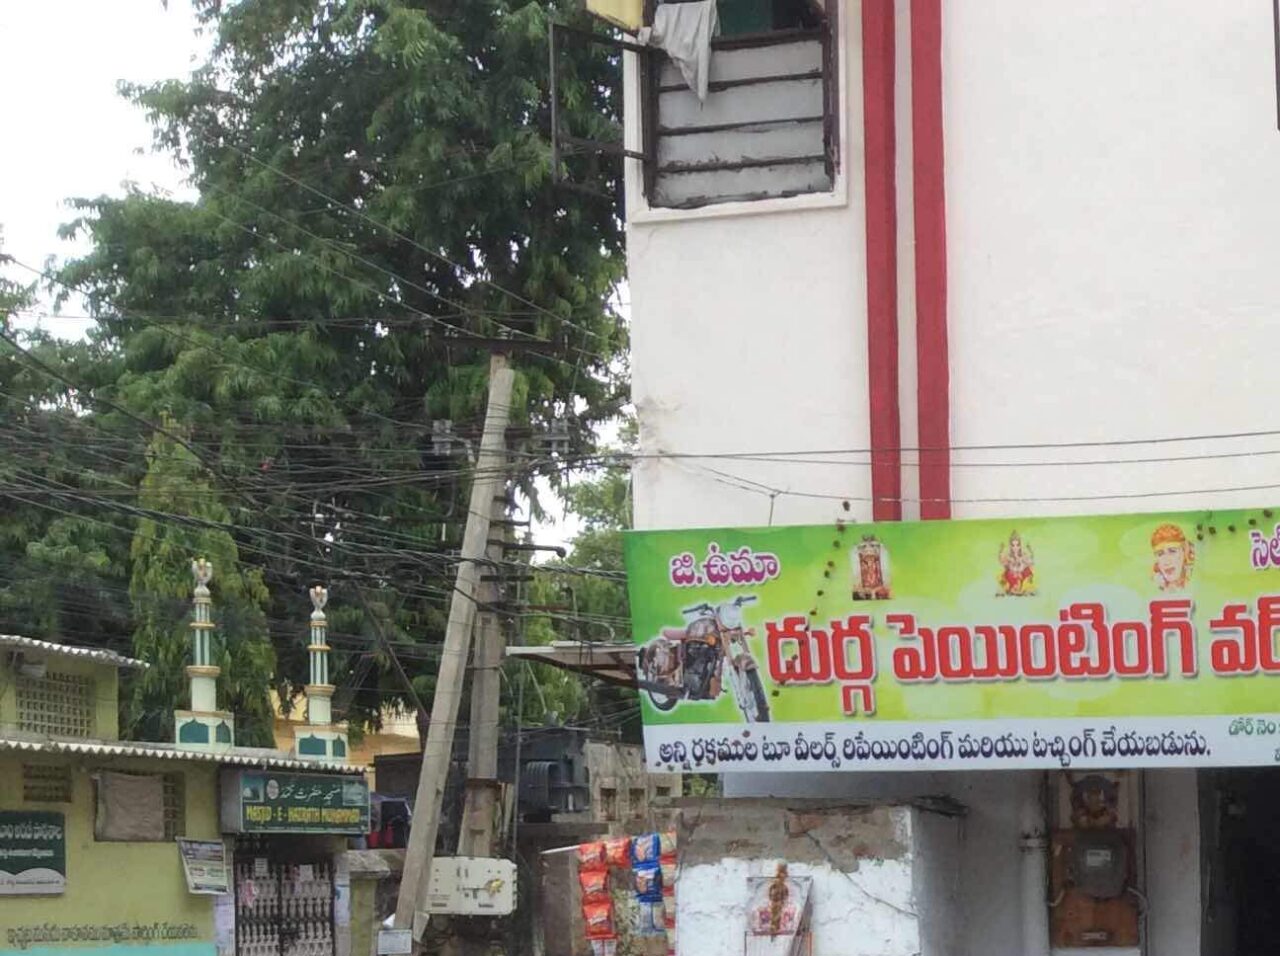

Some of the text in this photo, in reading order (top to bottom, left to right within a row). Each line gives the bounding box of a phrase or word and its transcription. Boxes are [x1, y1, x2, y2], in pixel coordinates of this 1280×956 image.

[766, 616, 874, 712] దుర్గ
[886, 600, 1196, 679] పెయింటింగ్
[659, 740, 692, 771] అన్ని
[762, 735, 791, 762] టూ
[794, 732, 842, 768] వీలర్స్
[843, 731, 954, 760] రిపేయింటింగ్
[958, 733, 1028, 759] మరియు
[1033, 728, 1096, 768] టచ్చింగ్
[1101, 726, 1211, 757] చేయబడును.
[1229, 717, 1254, 735] డోర్
